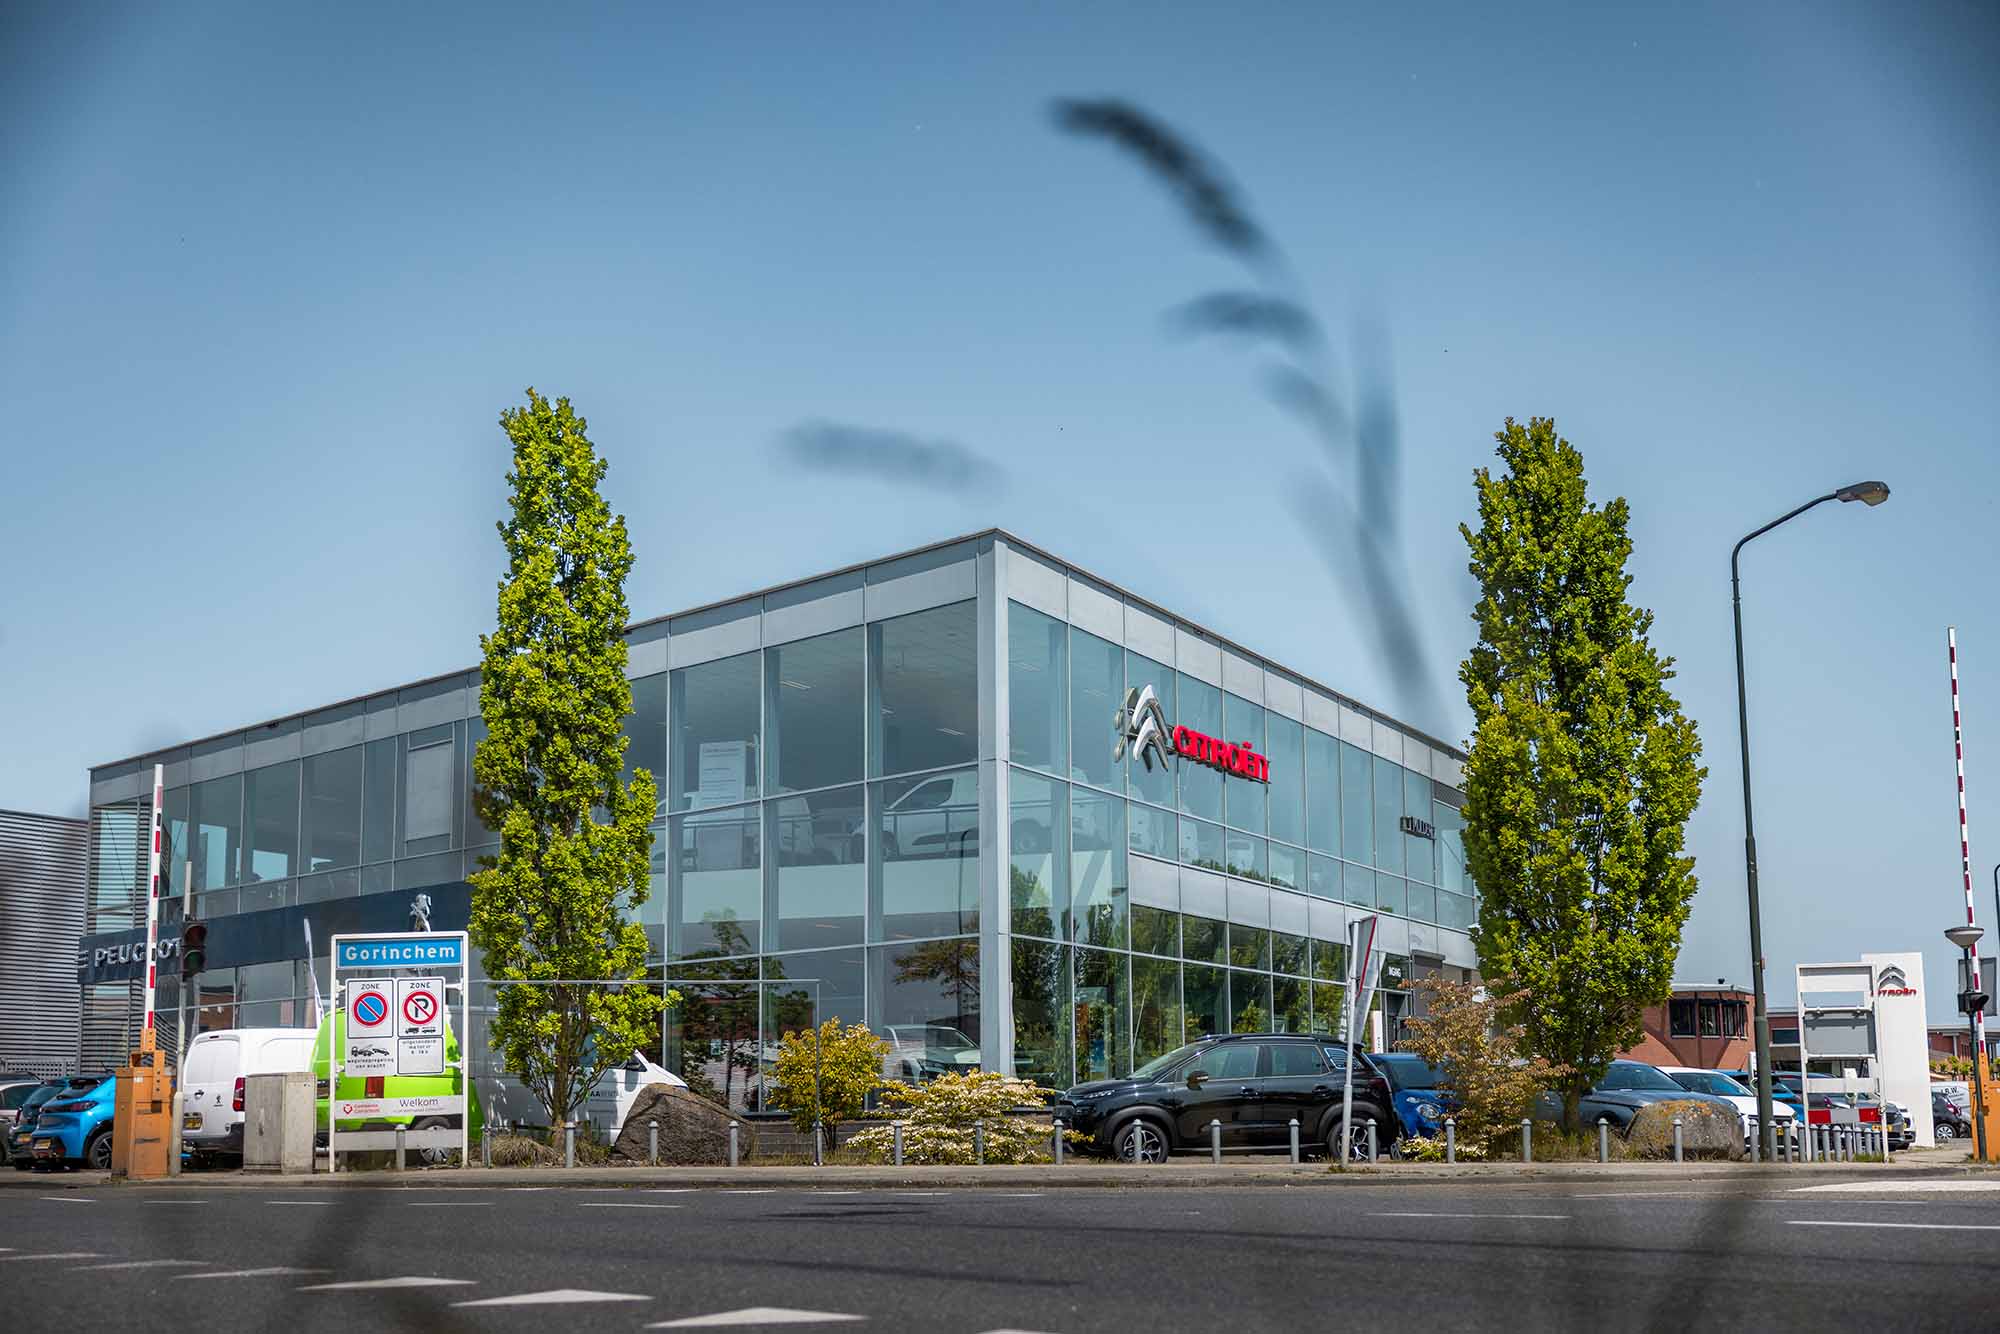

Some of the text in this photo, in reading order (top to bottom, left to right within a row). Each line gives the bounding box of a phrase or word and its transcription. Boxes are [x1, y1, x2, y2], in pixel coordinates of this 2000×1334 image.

[94, 937, 182, 968] PEUGOT
[346, 946, 454, 960] Gorinchem
[399, 1098, 439, 1107] Welkom
